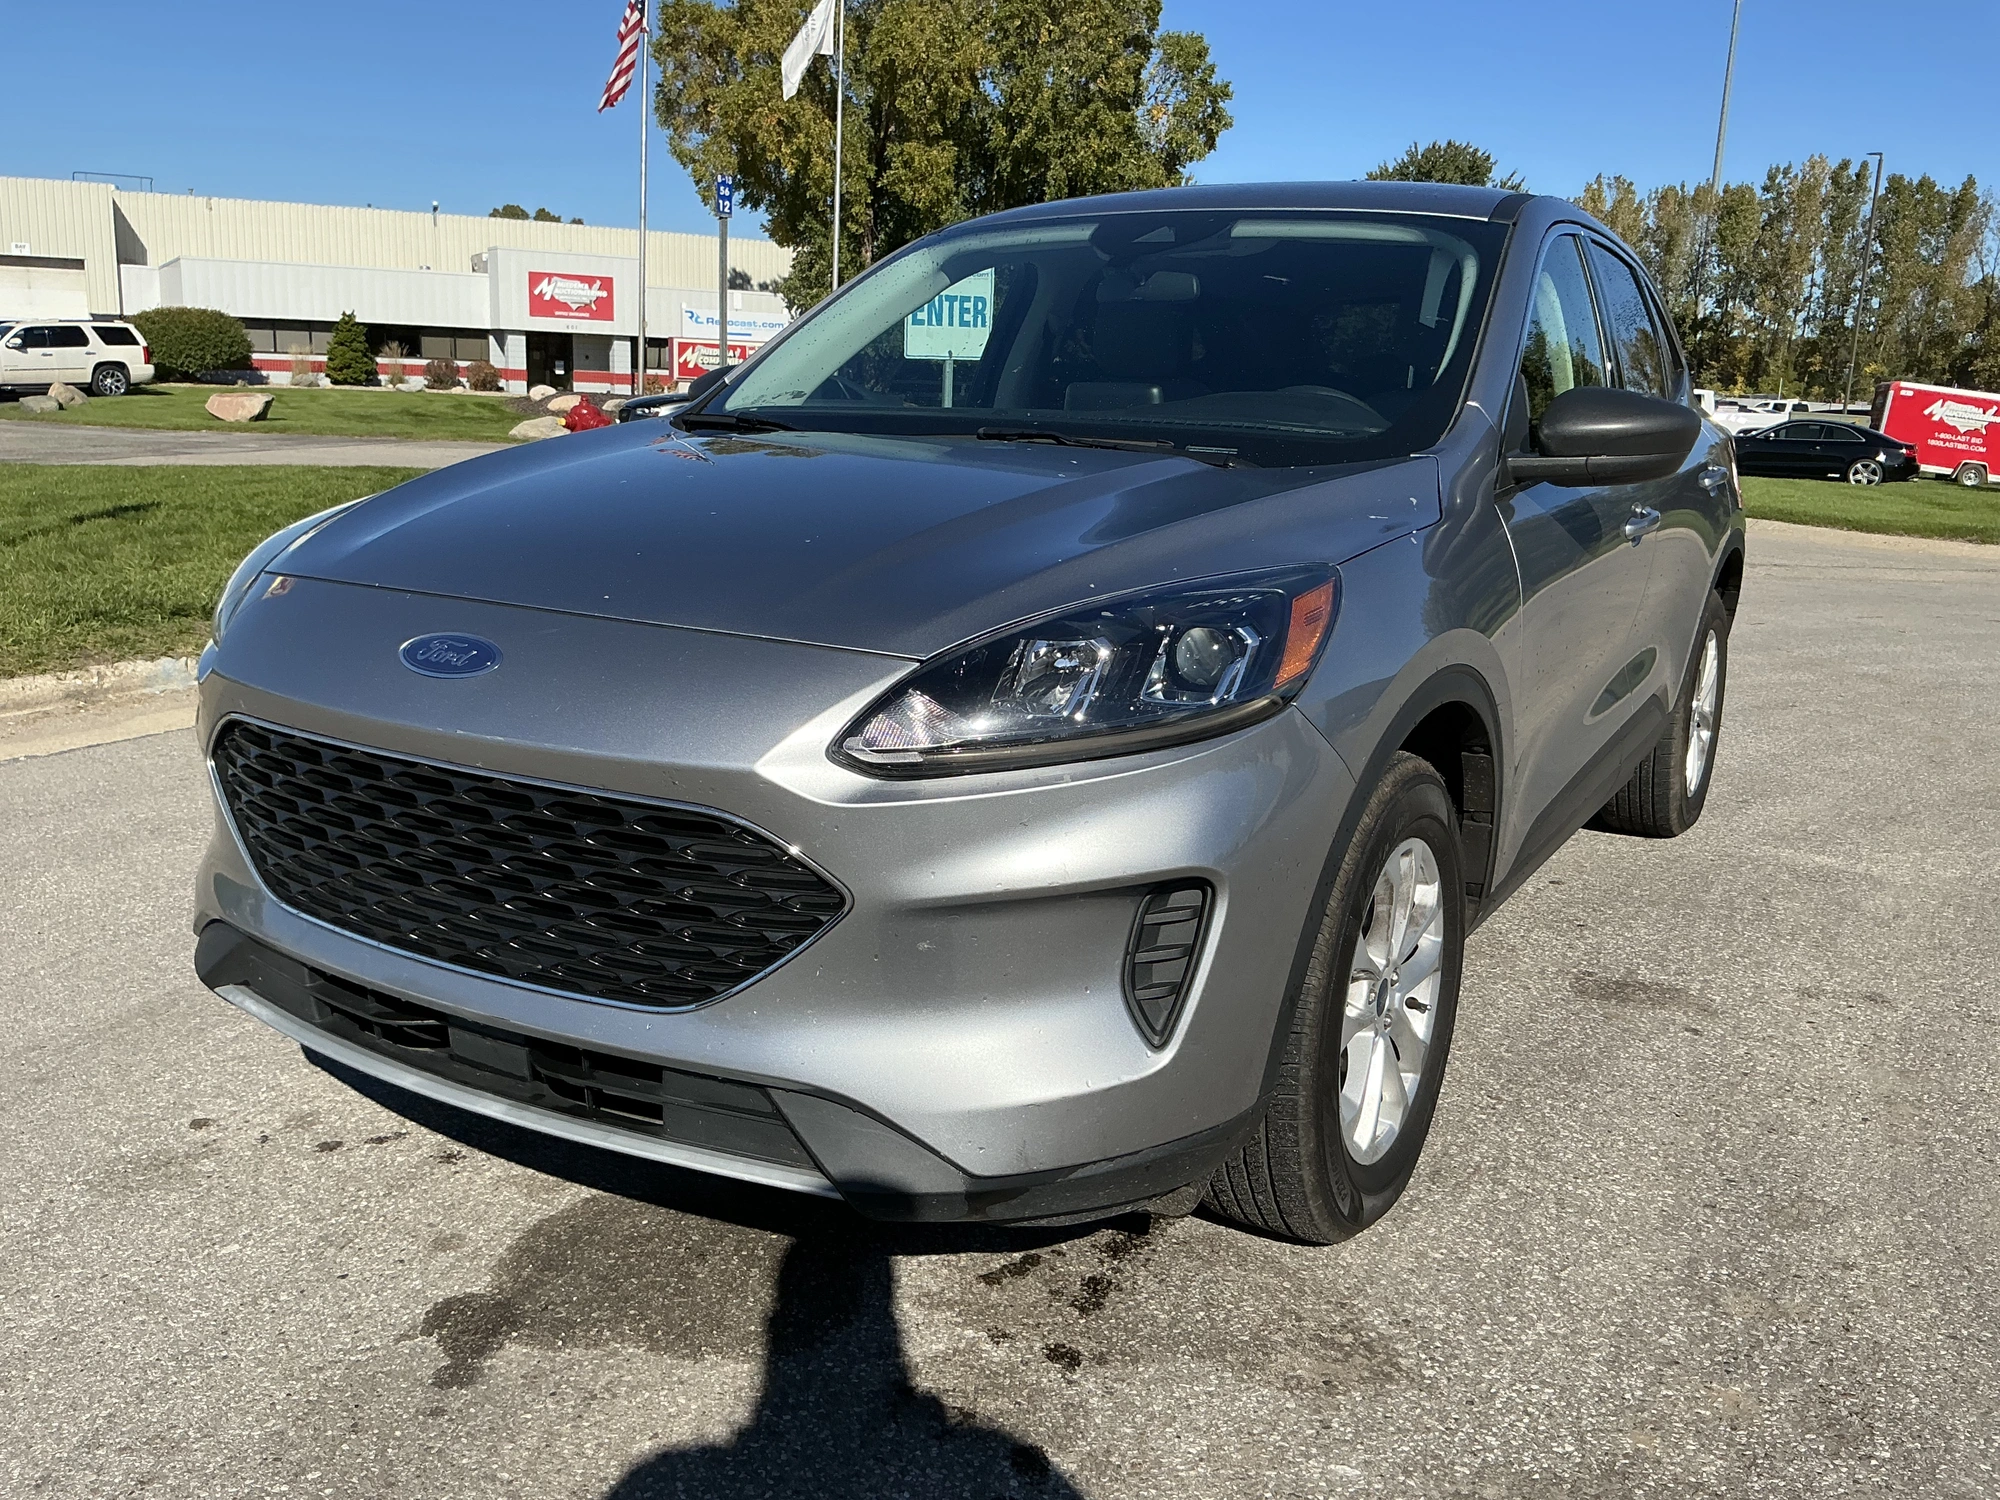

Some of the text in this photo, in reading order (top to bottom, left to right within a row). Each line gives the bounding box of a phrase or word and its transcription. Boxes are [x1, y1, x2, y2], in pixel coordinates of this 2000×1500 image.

[719, 186, 730, 197] 56
[718, 199, 731, 212] 12
[706, 317, 784, 329] Reocast.com
[416, 639, 478, 667] Ford
